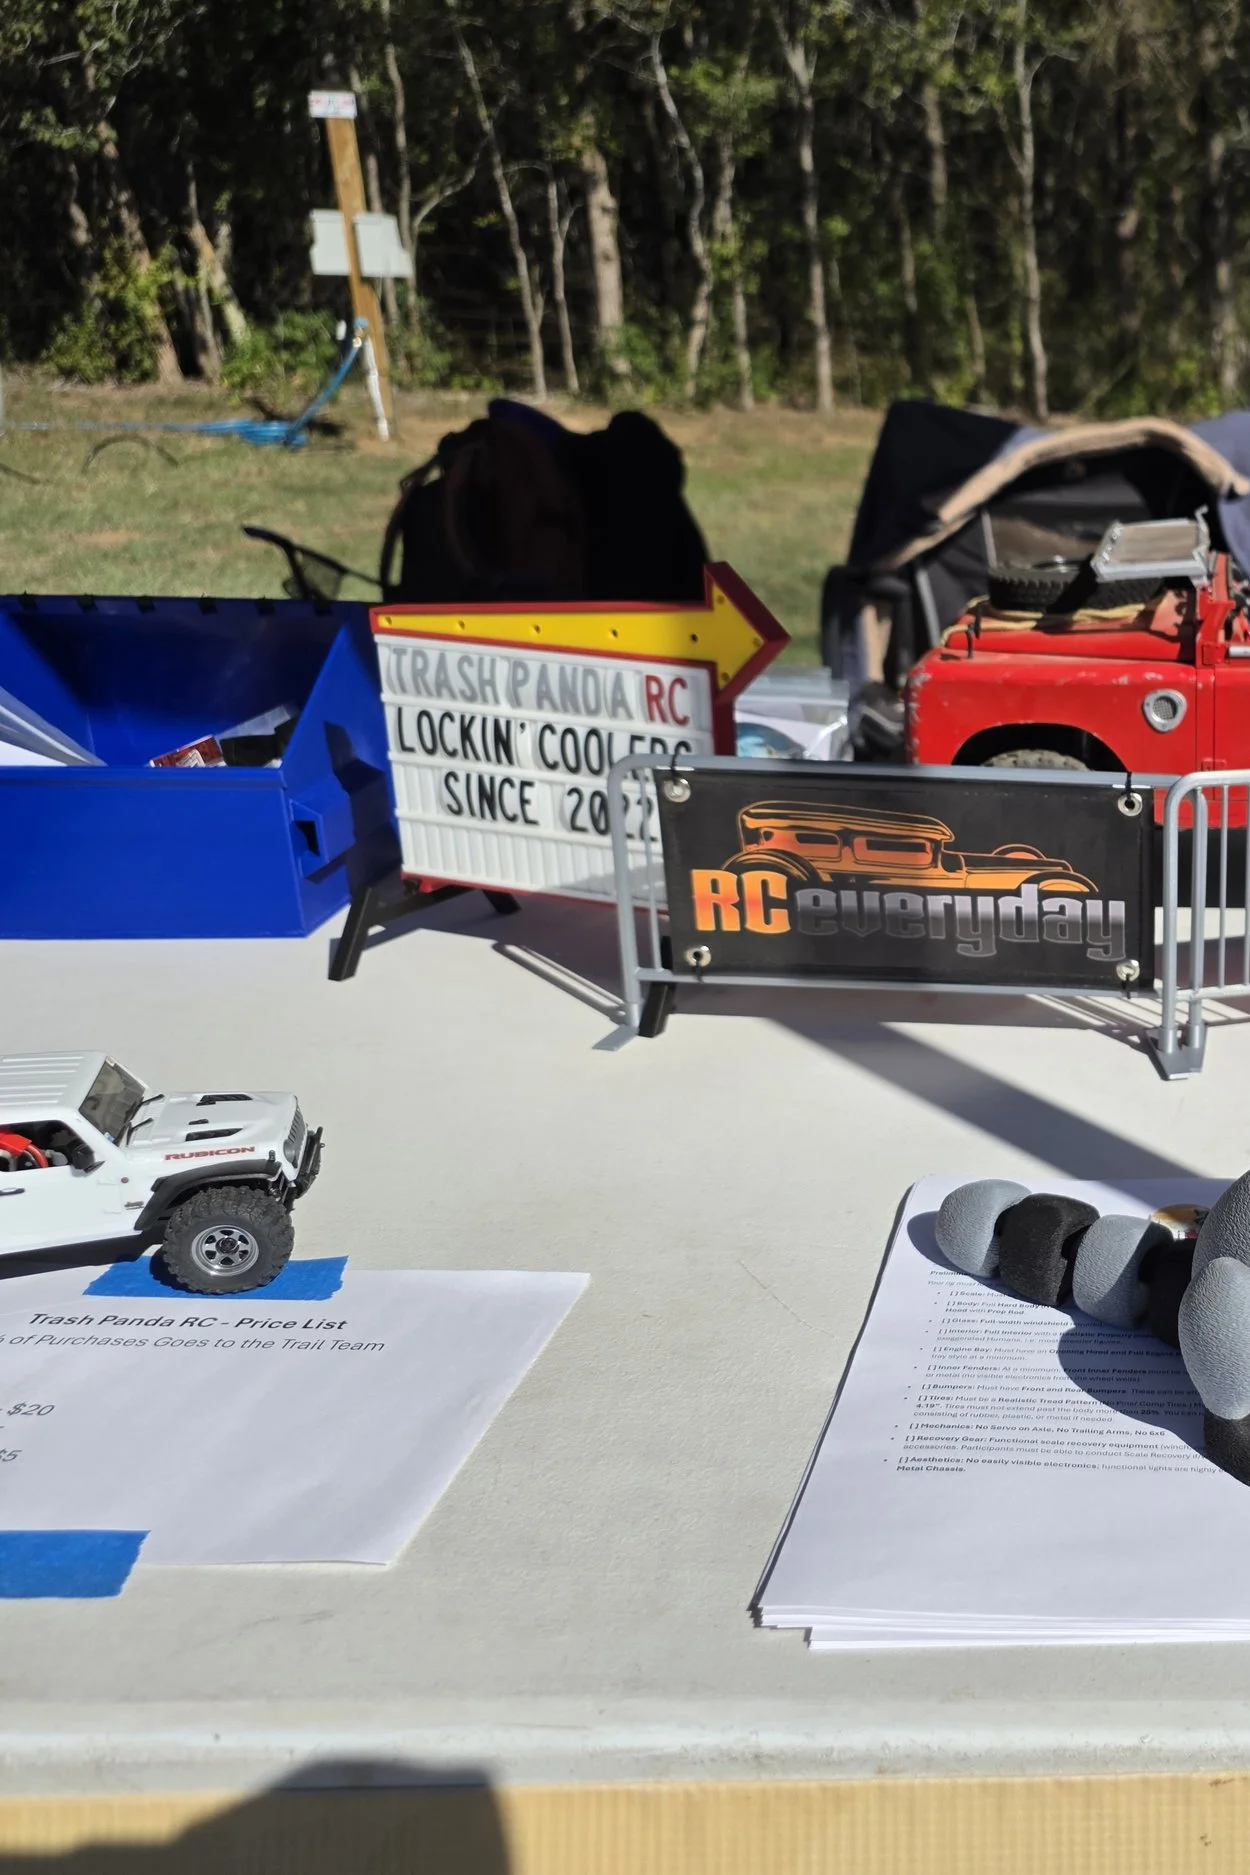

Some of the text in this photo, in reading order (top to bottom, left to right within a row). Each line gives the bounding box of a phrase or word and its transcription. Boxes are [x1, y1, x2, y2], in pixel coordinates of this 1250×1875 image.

[389, 649, 690, 726] TRASH PANDA RC
[397, 706, 528, 766] LOCKIN'
[443, 771, 539, 825] SINCE
[164, 1146, 256, 1161] RUBICON
[29, 1313, 348, 1330] Trash Panda RC Price List
[9, 1334, 38, 1345] of
[35, 1334, 149, 1347] Purchases
[154, 1336, 210, 1348] Goes
[214, 1338, 236, 1348] to
[240, 1338, 276, 1349] the
[282, 1338, 326, 1350] Trail
[330, 1340, 386, 1351] Team
[7, 1402, 56, 1416] $20
[1072, 1428, 1104, 1436] Trailing
[1106, 1429, 1132, 1437] Arms,
[1066, 1440, 1107, 1449] recovery
[1108, 1442, 1158, 1450] equipment
